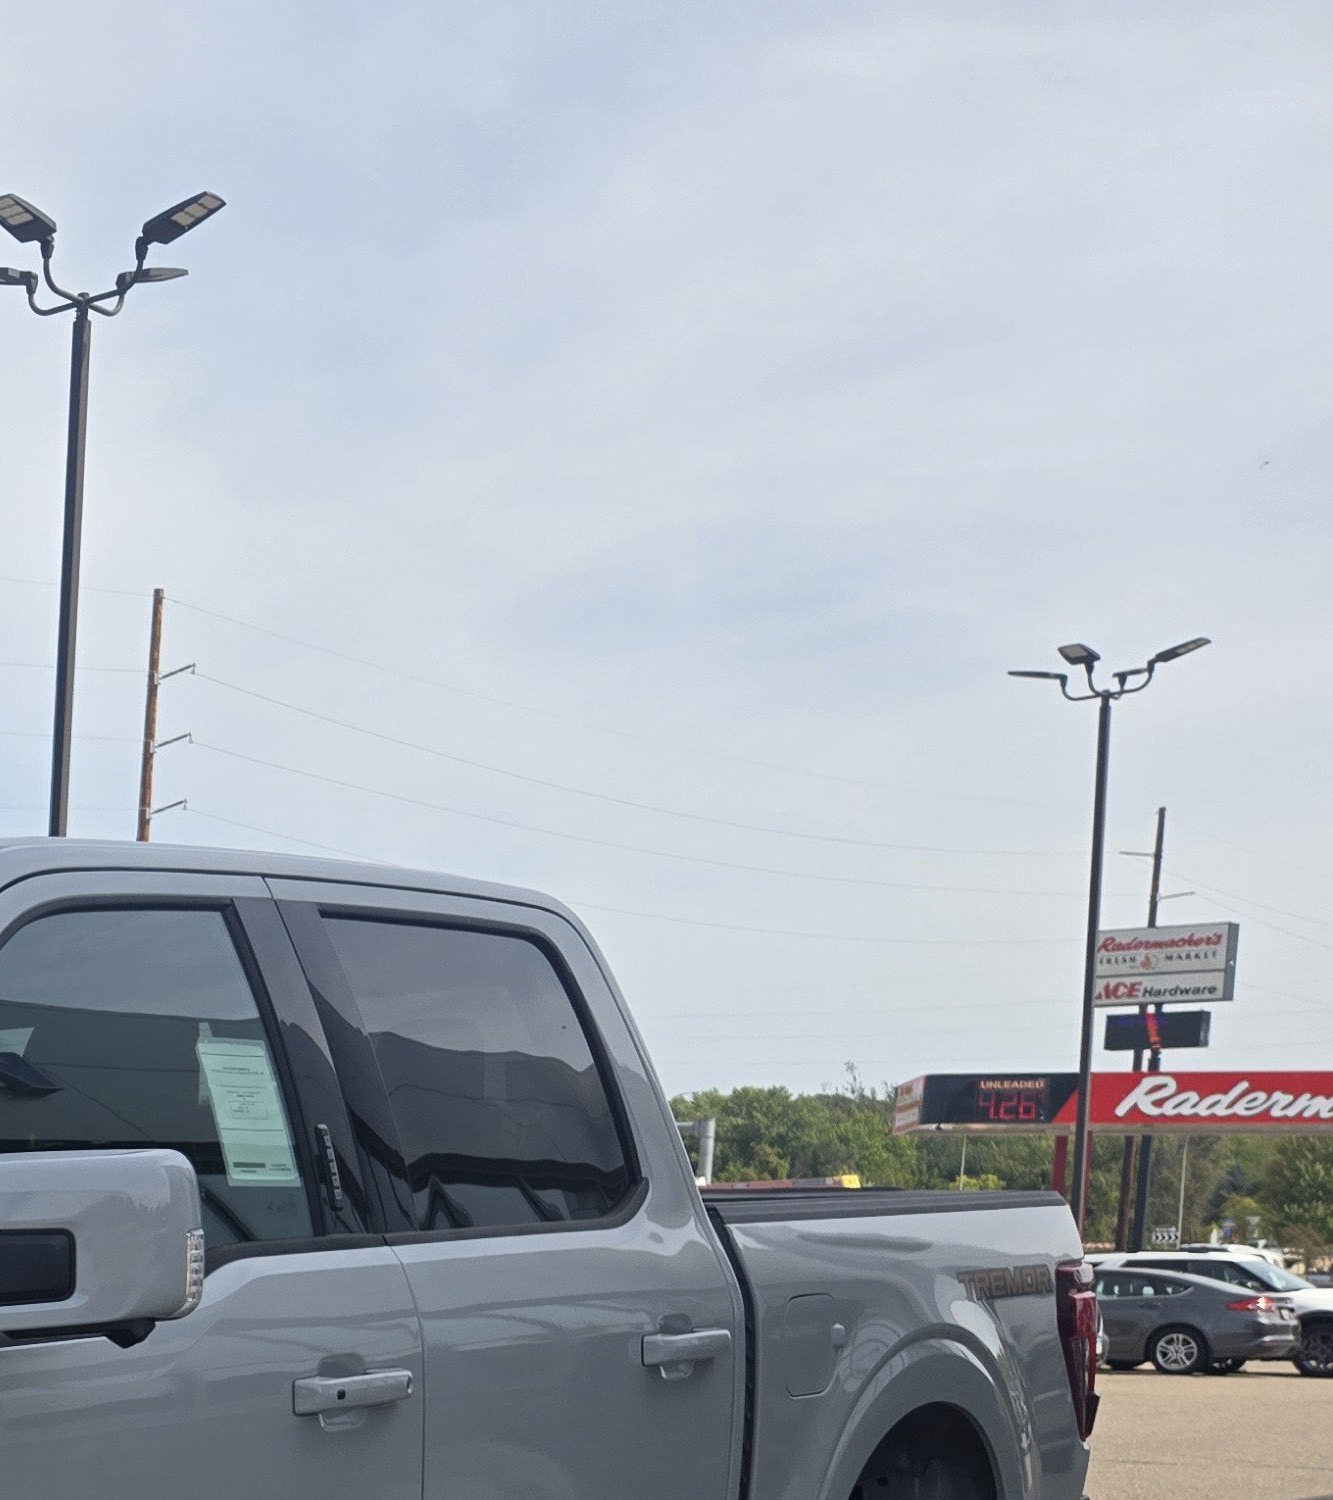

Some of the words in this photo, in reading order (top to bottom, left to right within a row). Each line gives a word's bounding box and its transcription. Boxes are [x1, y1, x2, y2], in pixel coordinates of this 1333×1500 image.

[1097, 932, 1223, 953] Radermacher's
[1099, 955, 1138, 965] FRESH
[1164, 950, 1218, 961] MARKET
[1094, 981, 1142, 1000] ACE
[1142, 984, 1217, 998] Hardware
[980, 1079, 1046, 1089] UNLEADED
[1114, 1075, 1333, 1119] Raderm
[956, 1263, 1054, 1302] TREMOR
